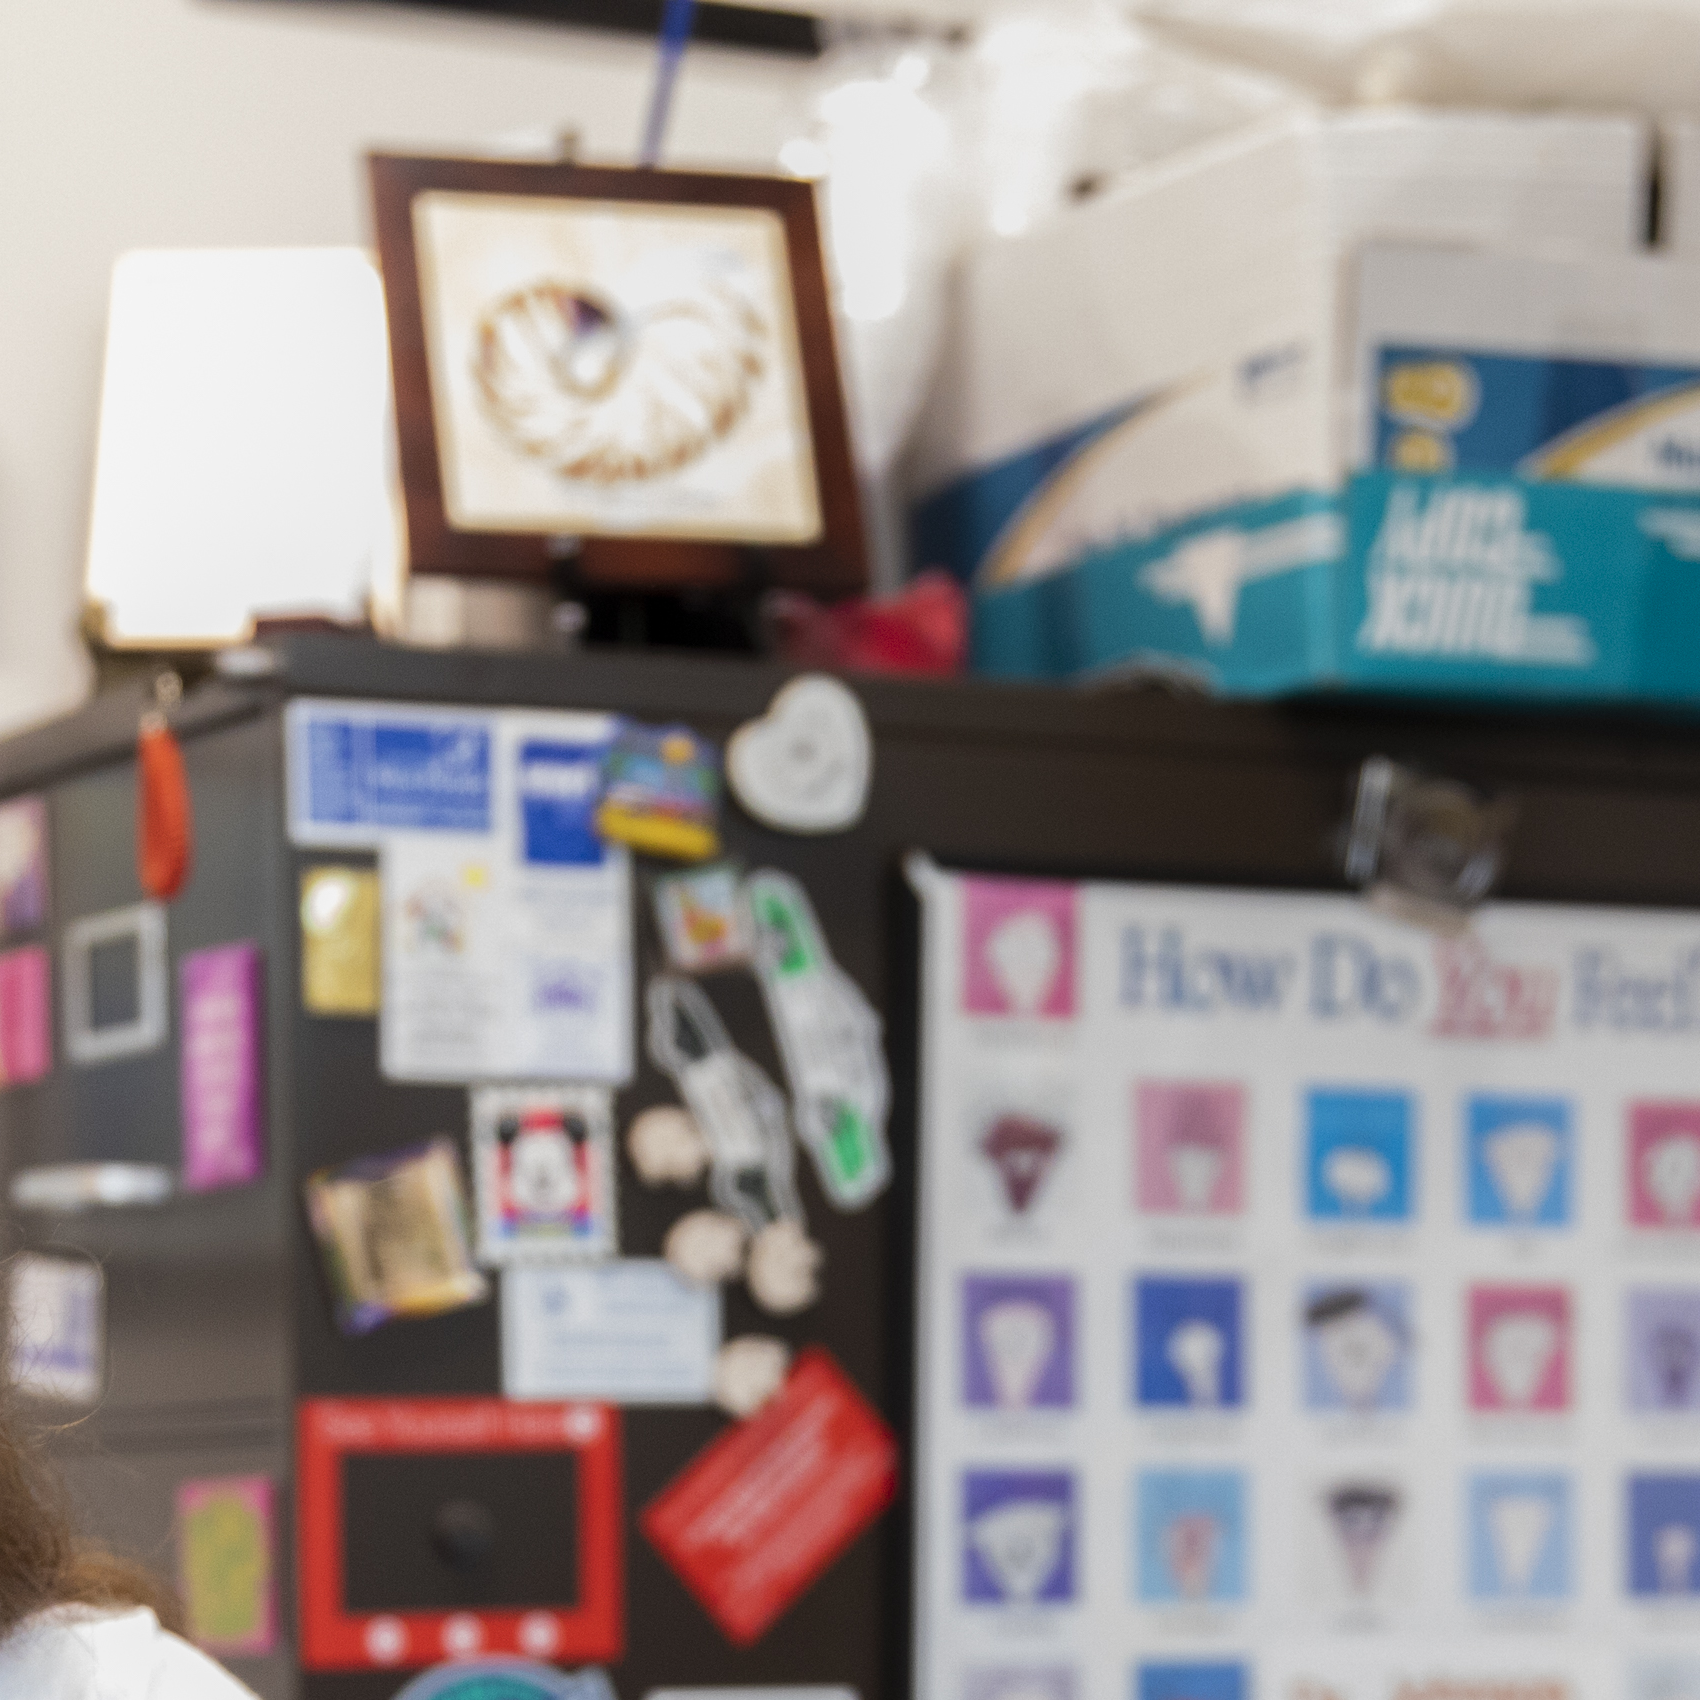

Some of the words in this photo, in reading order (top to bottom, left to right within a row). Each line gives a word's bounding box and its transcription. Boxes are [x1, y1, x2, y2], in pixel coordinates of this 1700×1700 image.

[1119, 924, 1297, 1015] How
[1311, 932, 1422, 1020] Do
[1430, 940, 1557, 1039] You
